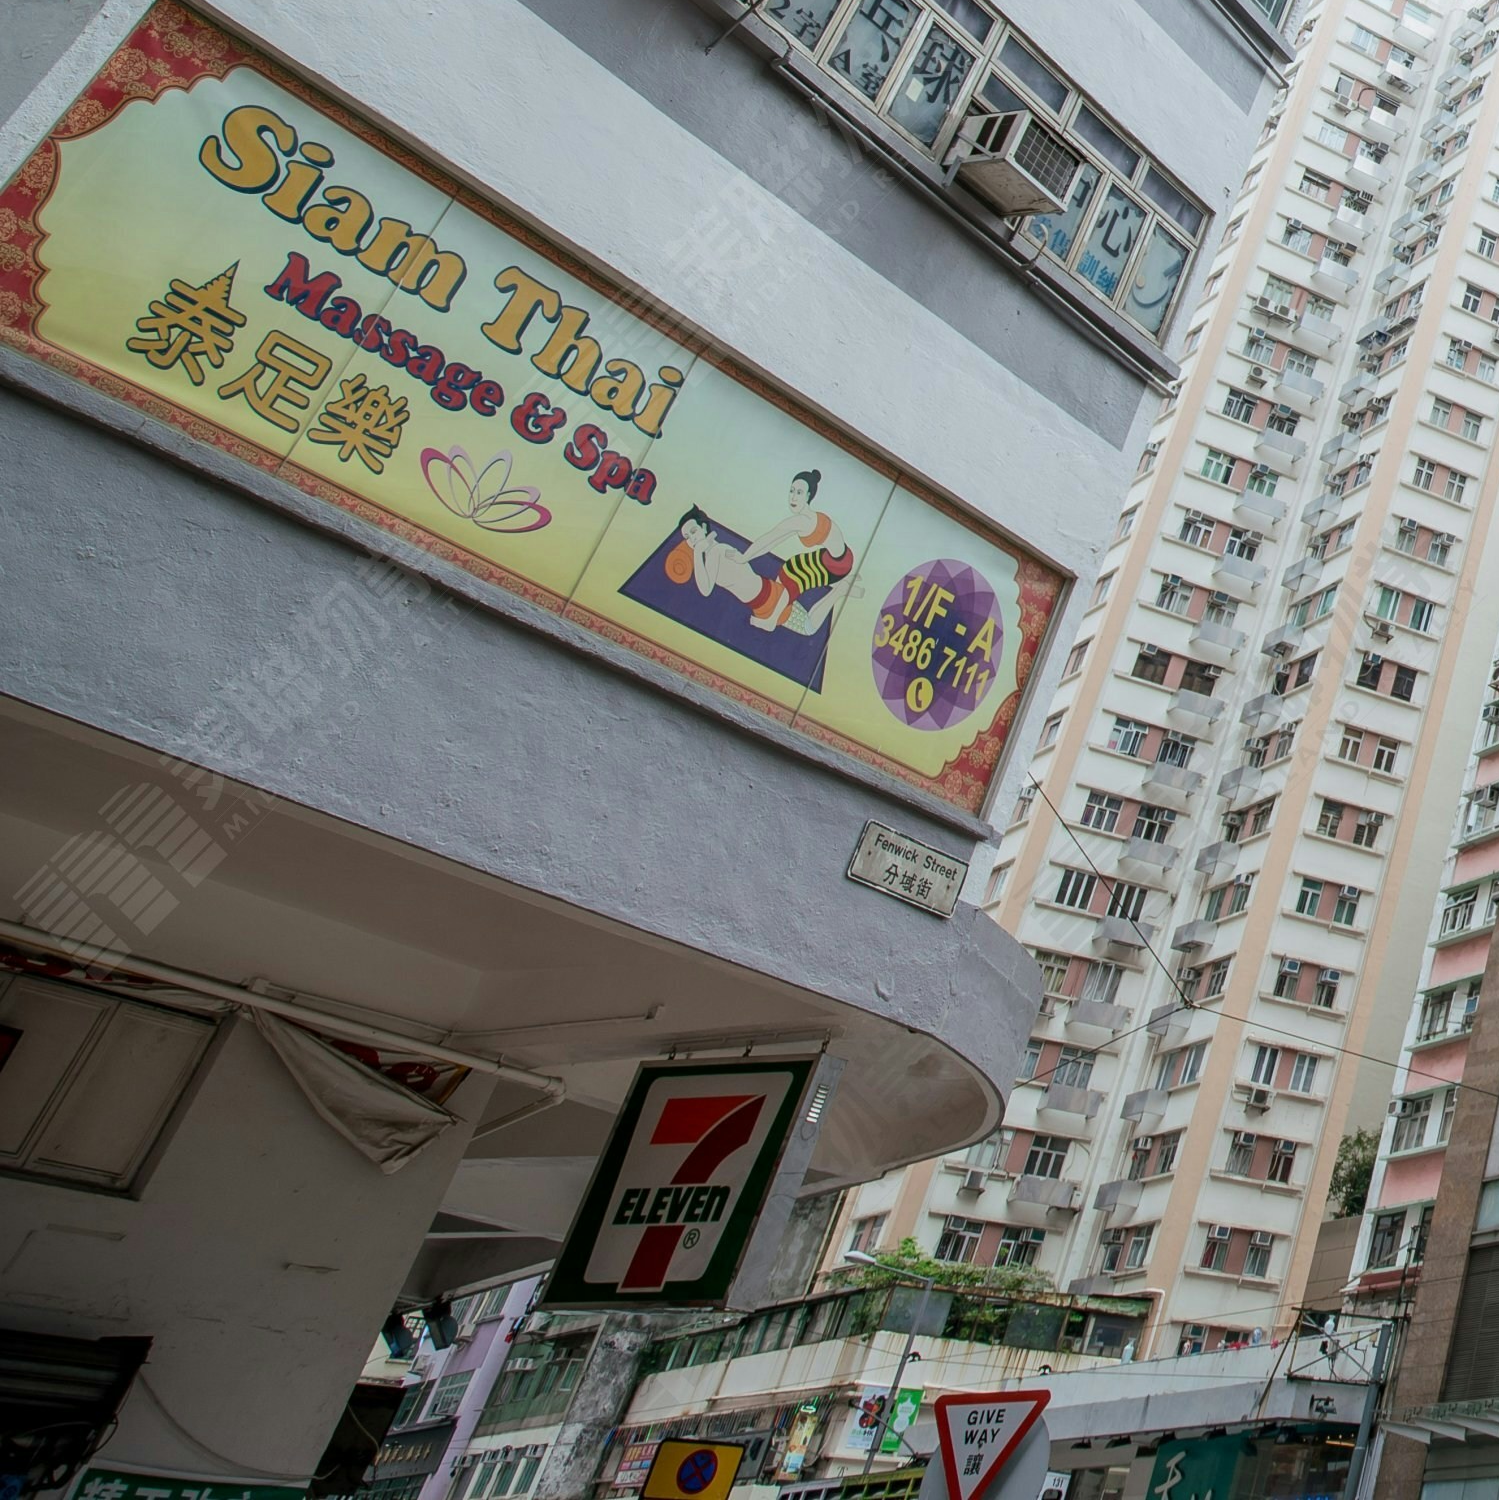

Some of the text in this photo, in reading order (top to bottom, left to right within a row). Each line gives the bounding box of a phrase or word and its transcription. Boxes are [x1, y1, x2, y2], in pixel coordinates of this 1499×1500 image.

[200, 104, 468, 313] Siam
[494, 264, 685, 439] Thai
[126, 262, 411, 474] 泰足樂
[262, 251, 657, 506] Massage & Spa
[902, 575, 956, 629] 1/F
[966, 617, 996, 663] A
[874, 613, 990, 701] 3486 7111
[874, 833, 958, 882] Fenwick Street
[883, 863, 934, 900] 分域街
[963, 1427, 1002, 1446] WAY
[966, 1407, 1007, 1426] GIVE
[963, 1453, 984, 1478] 讓
